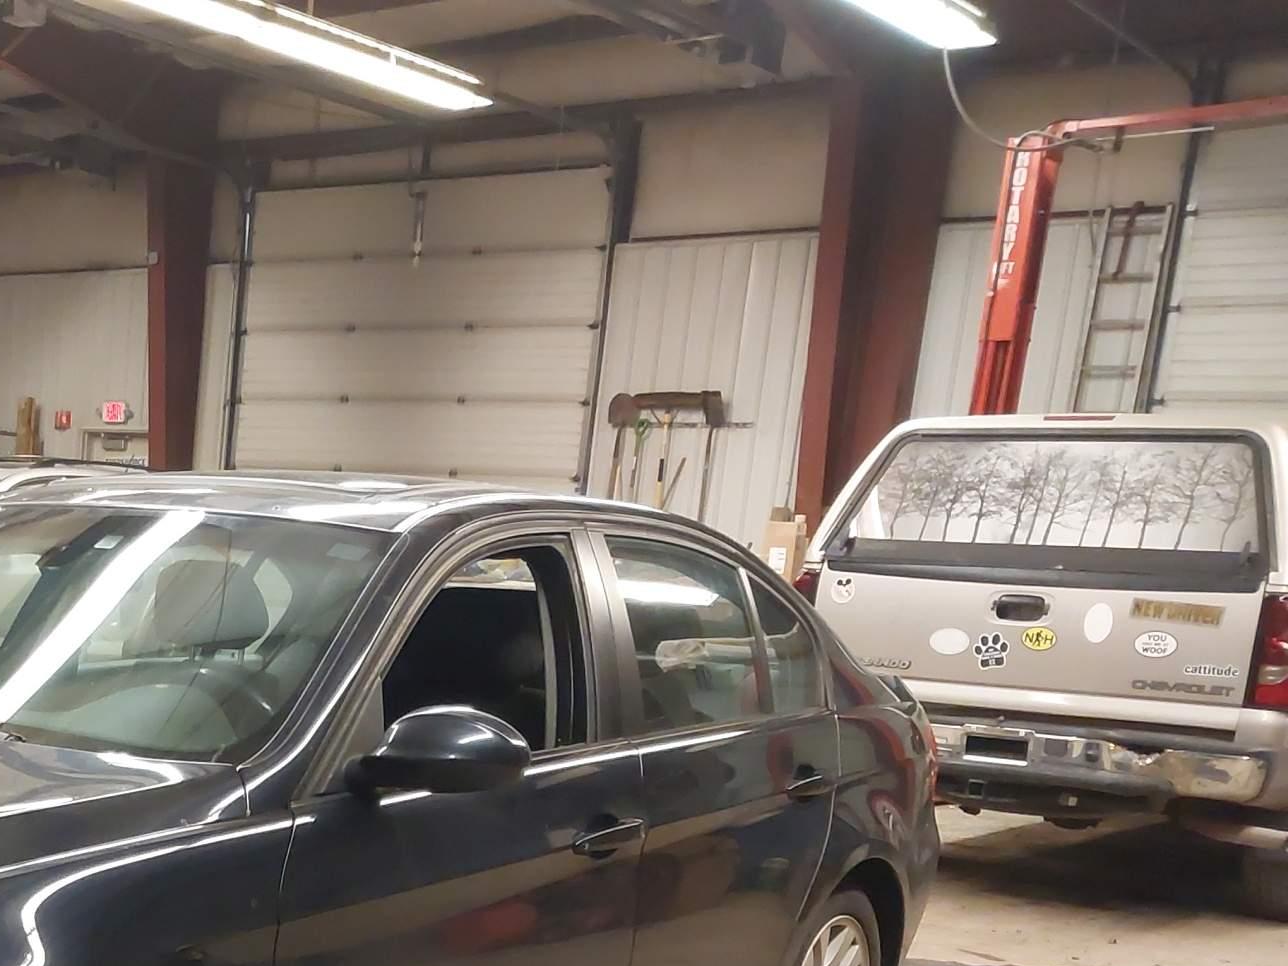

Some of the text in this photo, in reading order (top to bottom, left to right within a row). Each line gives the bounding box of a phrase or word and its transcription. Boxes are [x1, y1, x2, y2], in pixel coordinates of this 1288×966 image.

[1002, 148, 1030, 261] ROTARY
[1147, 634, 1167, 642] YOU
[1142, 646, 1168, 654] WOOF
[1184, 664, 1239, 677] cattitude
